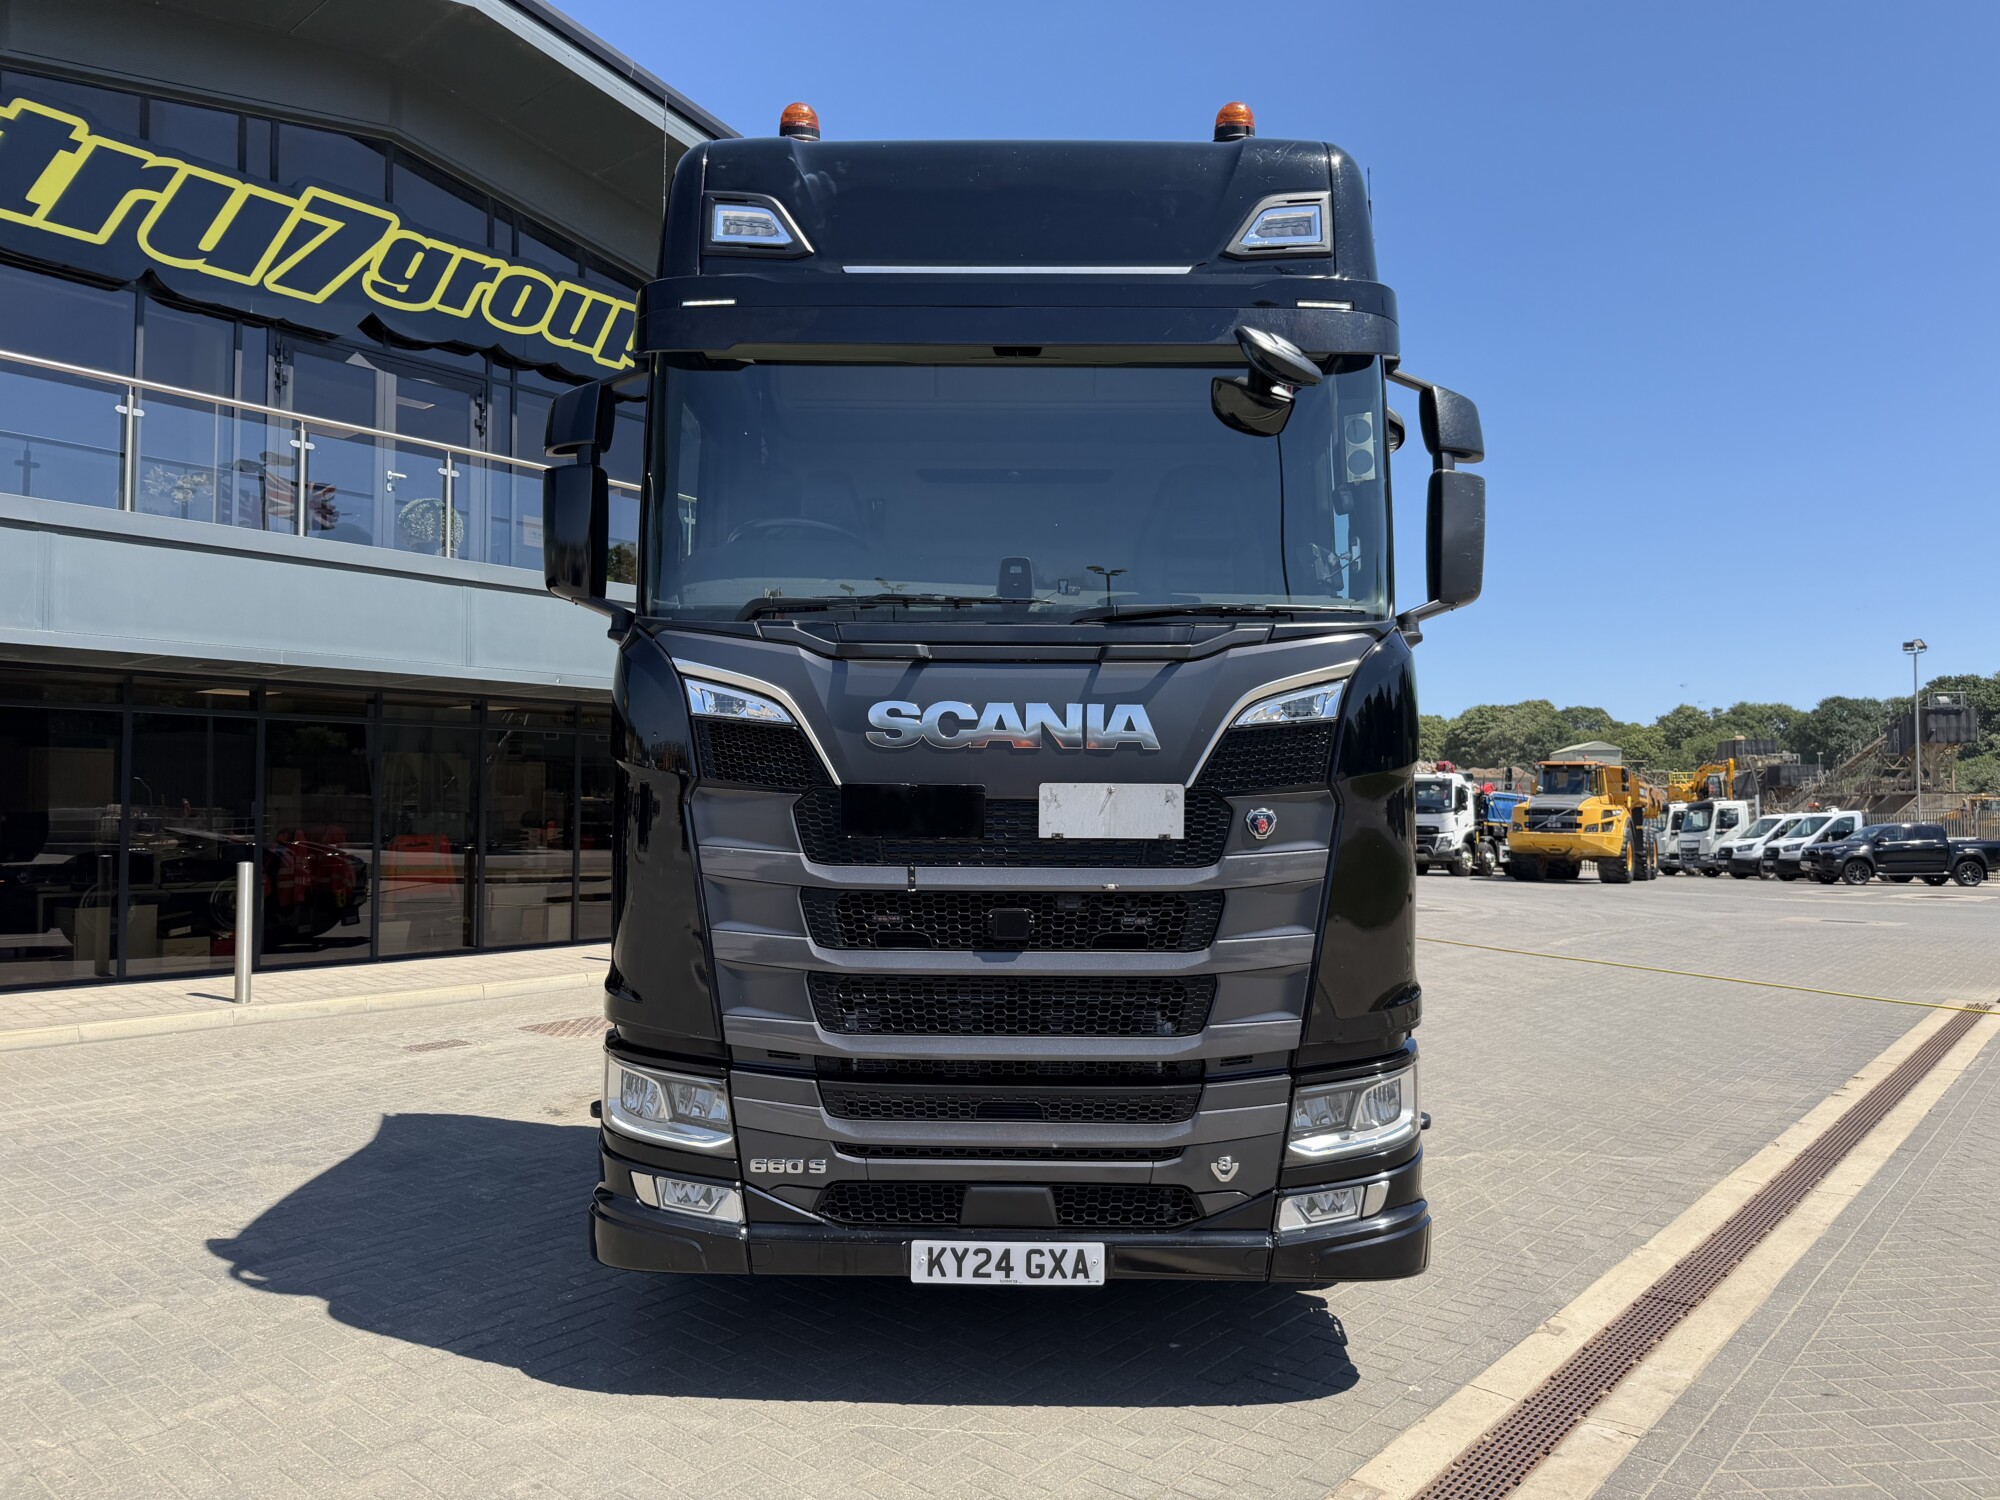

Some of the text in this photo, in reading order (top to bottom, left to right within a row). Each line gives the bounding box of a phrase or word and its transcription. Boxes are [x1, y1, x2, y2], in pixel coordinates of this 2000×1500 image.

[866, 700, 1161, 750] SCANIA
[750, 1158, 827, 1174] 660 S
[927, 1246, 1090, 1280] KY24 GXA
